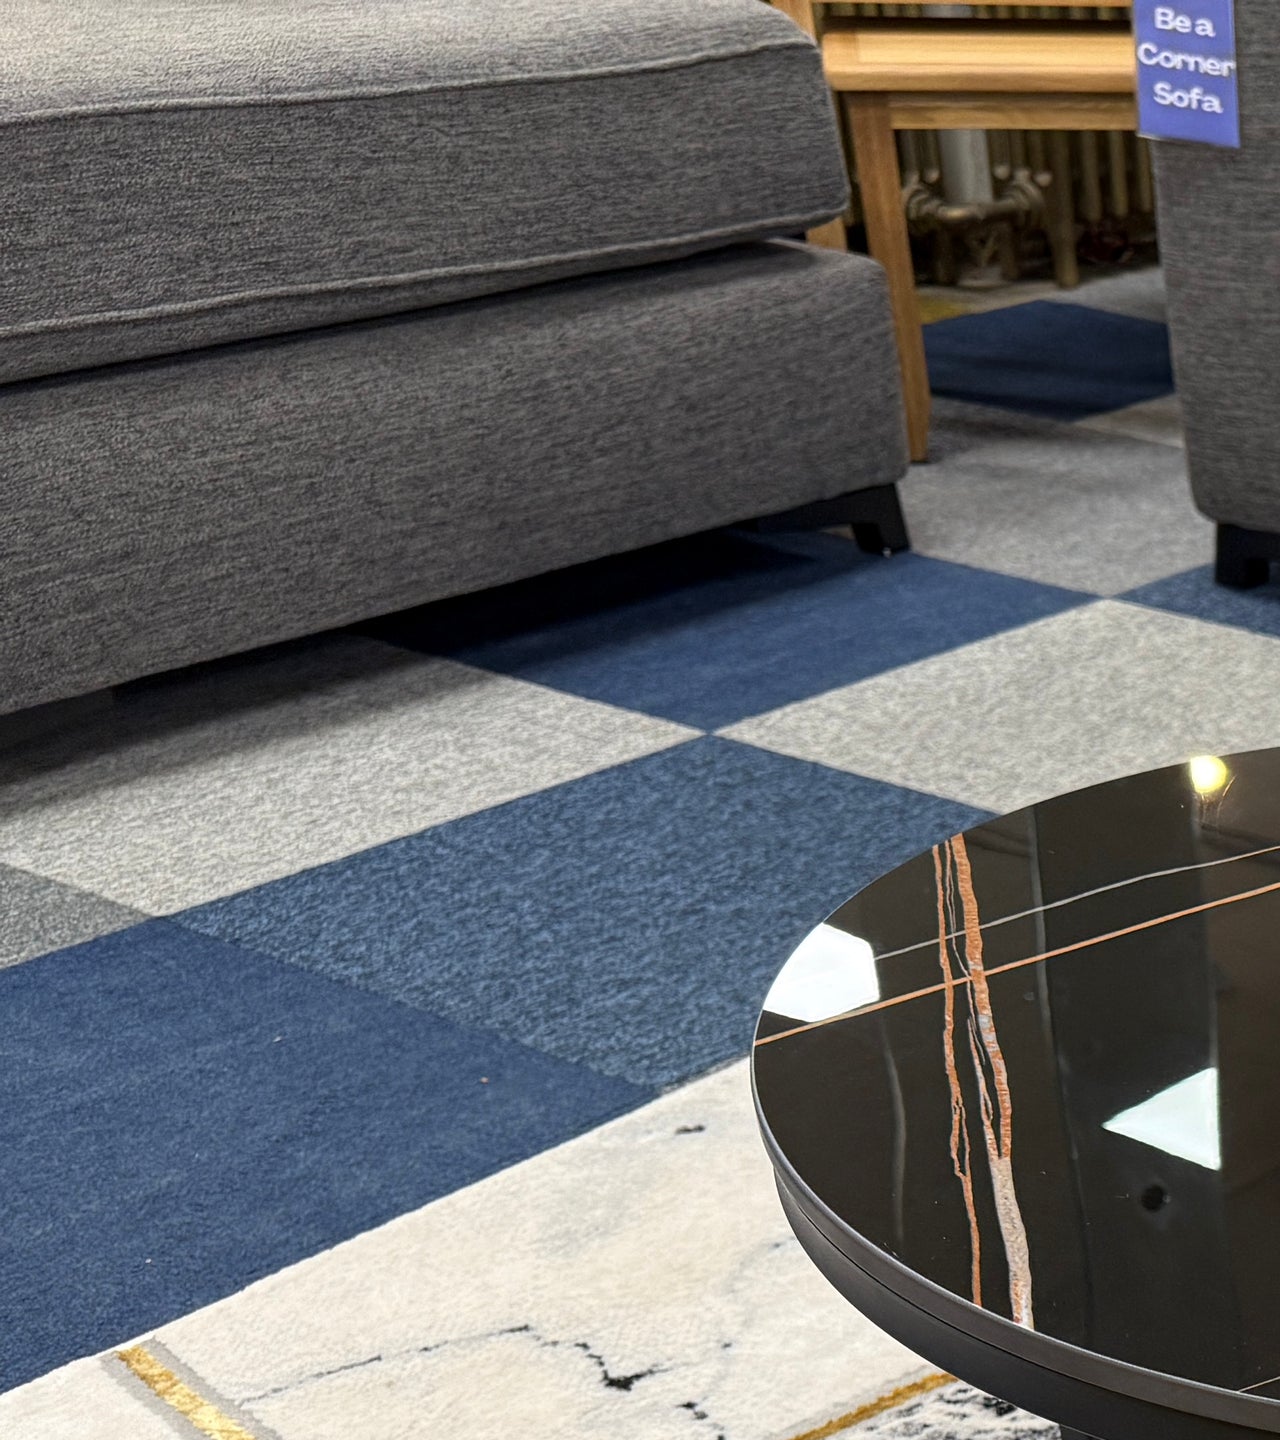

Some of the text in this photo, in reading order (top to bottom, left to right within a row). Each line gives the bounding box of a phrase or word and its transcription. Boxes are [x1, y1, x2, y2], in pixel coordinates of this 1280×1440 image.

[1154, 7, 1216, 38] Be a
[1138, 42, 1236, 77] Corner
[1153, 81, 1224, 113] Sofa
